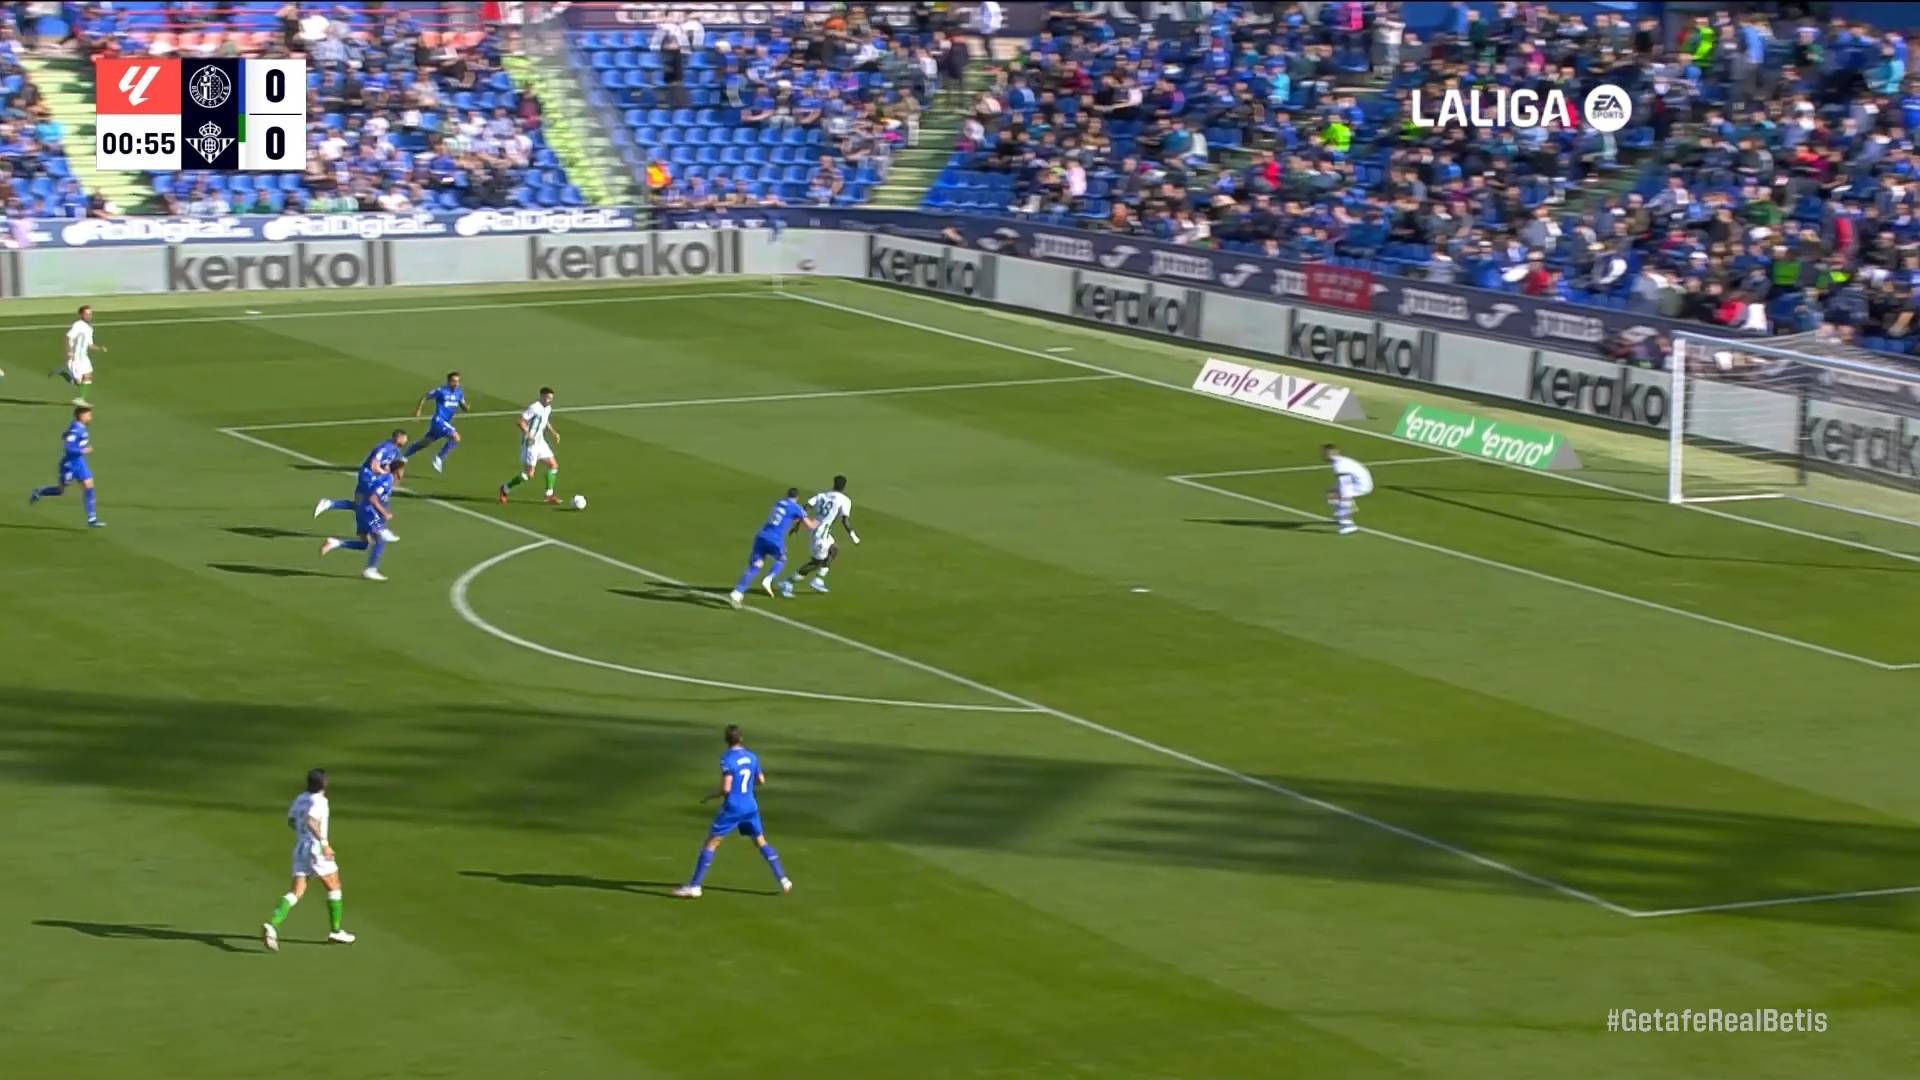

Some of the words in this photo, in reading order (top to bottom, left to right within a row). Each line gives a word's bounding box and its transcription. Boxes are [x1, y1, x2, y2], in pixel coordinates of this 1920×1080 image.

[167, 241, 392, 290] kerakoll
[527, 230, 742, 280] kerakoll
[867, 234, 997, 299] kerakoll
[1072, 270, 1204, 337] kerakoll
[1287, 308, 1437, 381] kerakoll
[1203, 368, 1260, 394] renfe
[1262, 374, 1334, 411] AVE
[1529, 349, 1690, 429] kerako
[739, 768, 752, 794] 7
